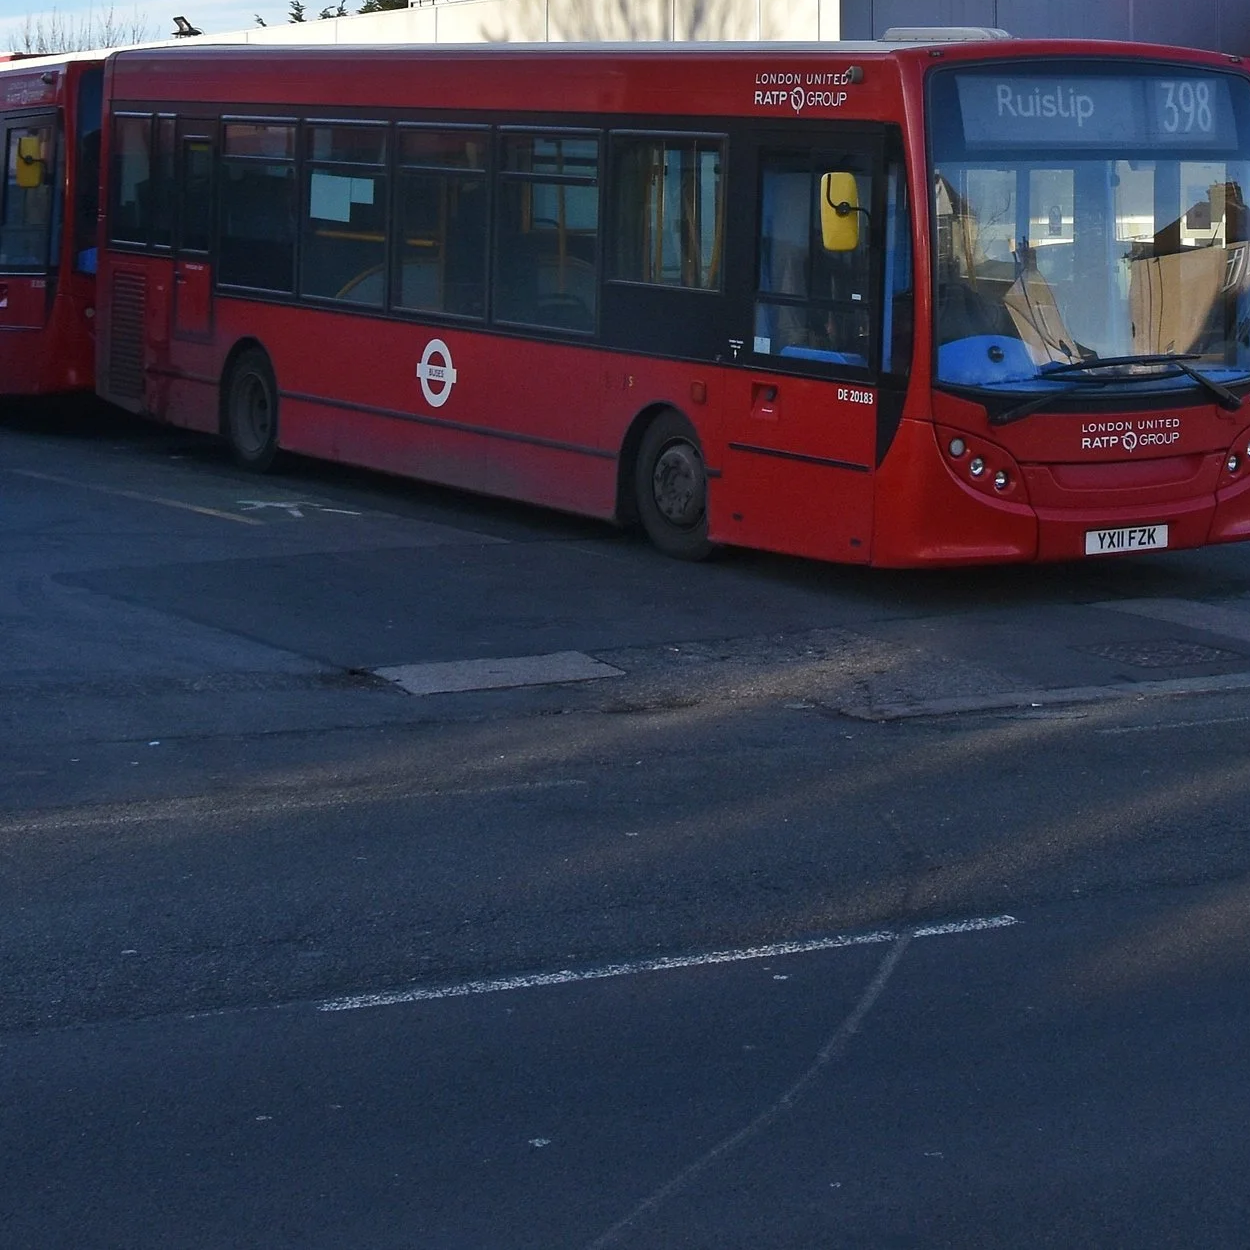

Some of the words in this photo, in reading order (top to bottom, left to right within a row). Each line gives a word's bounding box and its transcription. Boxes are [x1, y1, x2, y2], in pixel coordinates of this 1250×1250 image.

[755, 73, 801, 85] LONDON
[806, 73, 850, 85] UNITED
[754, 91, 788, 105] RATP
[806, 91, 847, 106] GROUP
[996, 84, 1094, 127] Ruislip
[1160, 82, 1212, 133] 398
[838, 388, 848, 400] DE
[850, 390, 874, 405] 20183
[1081, 421, 1132, 432] LONDON
[1138, 418, 1180, 430] UNITED
[1081, 436, 1119, 449] RATP
[1139, 432, 1180, 446] GROUP
[1098, 530, 1125, 549] YX11
[1128, 527, 1157, 547] FZK
